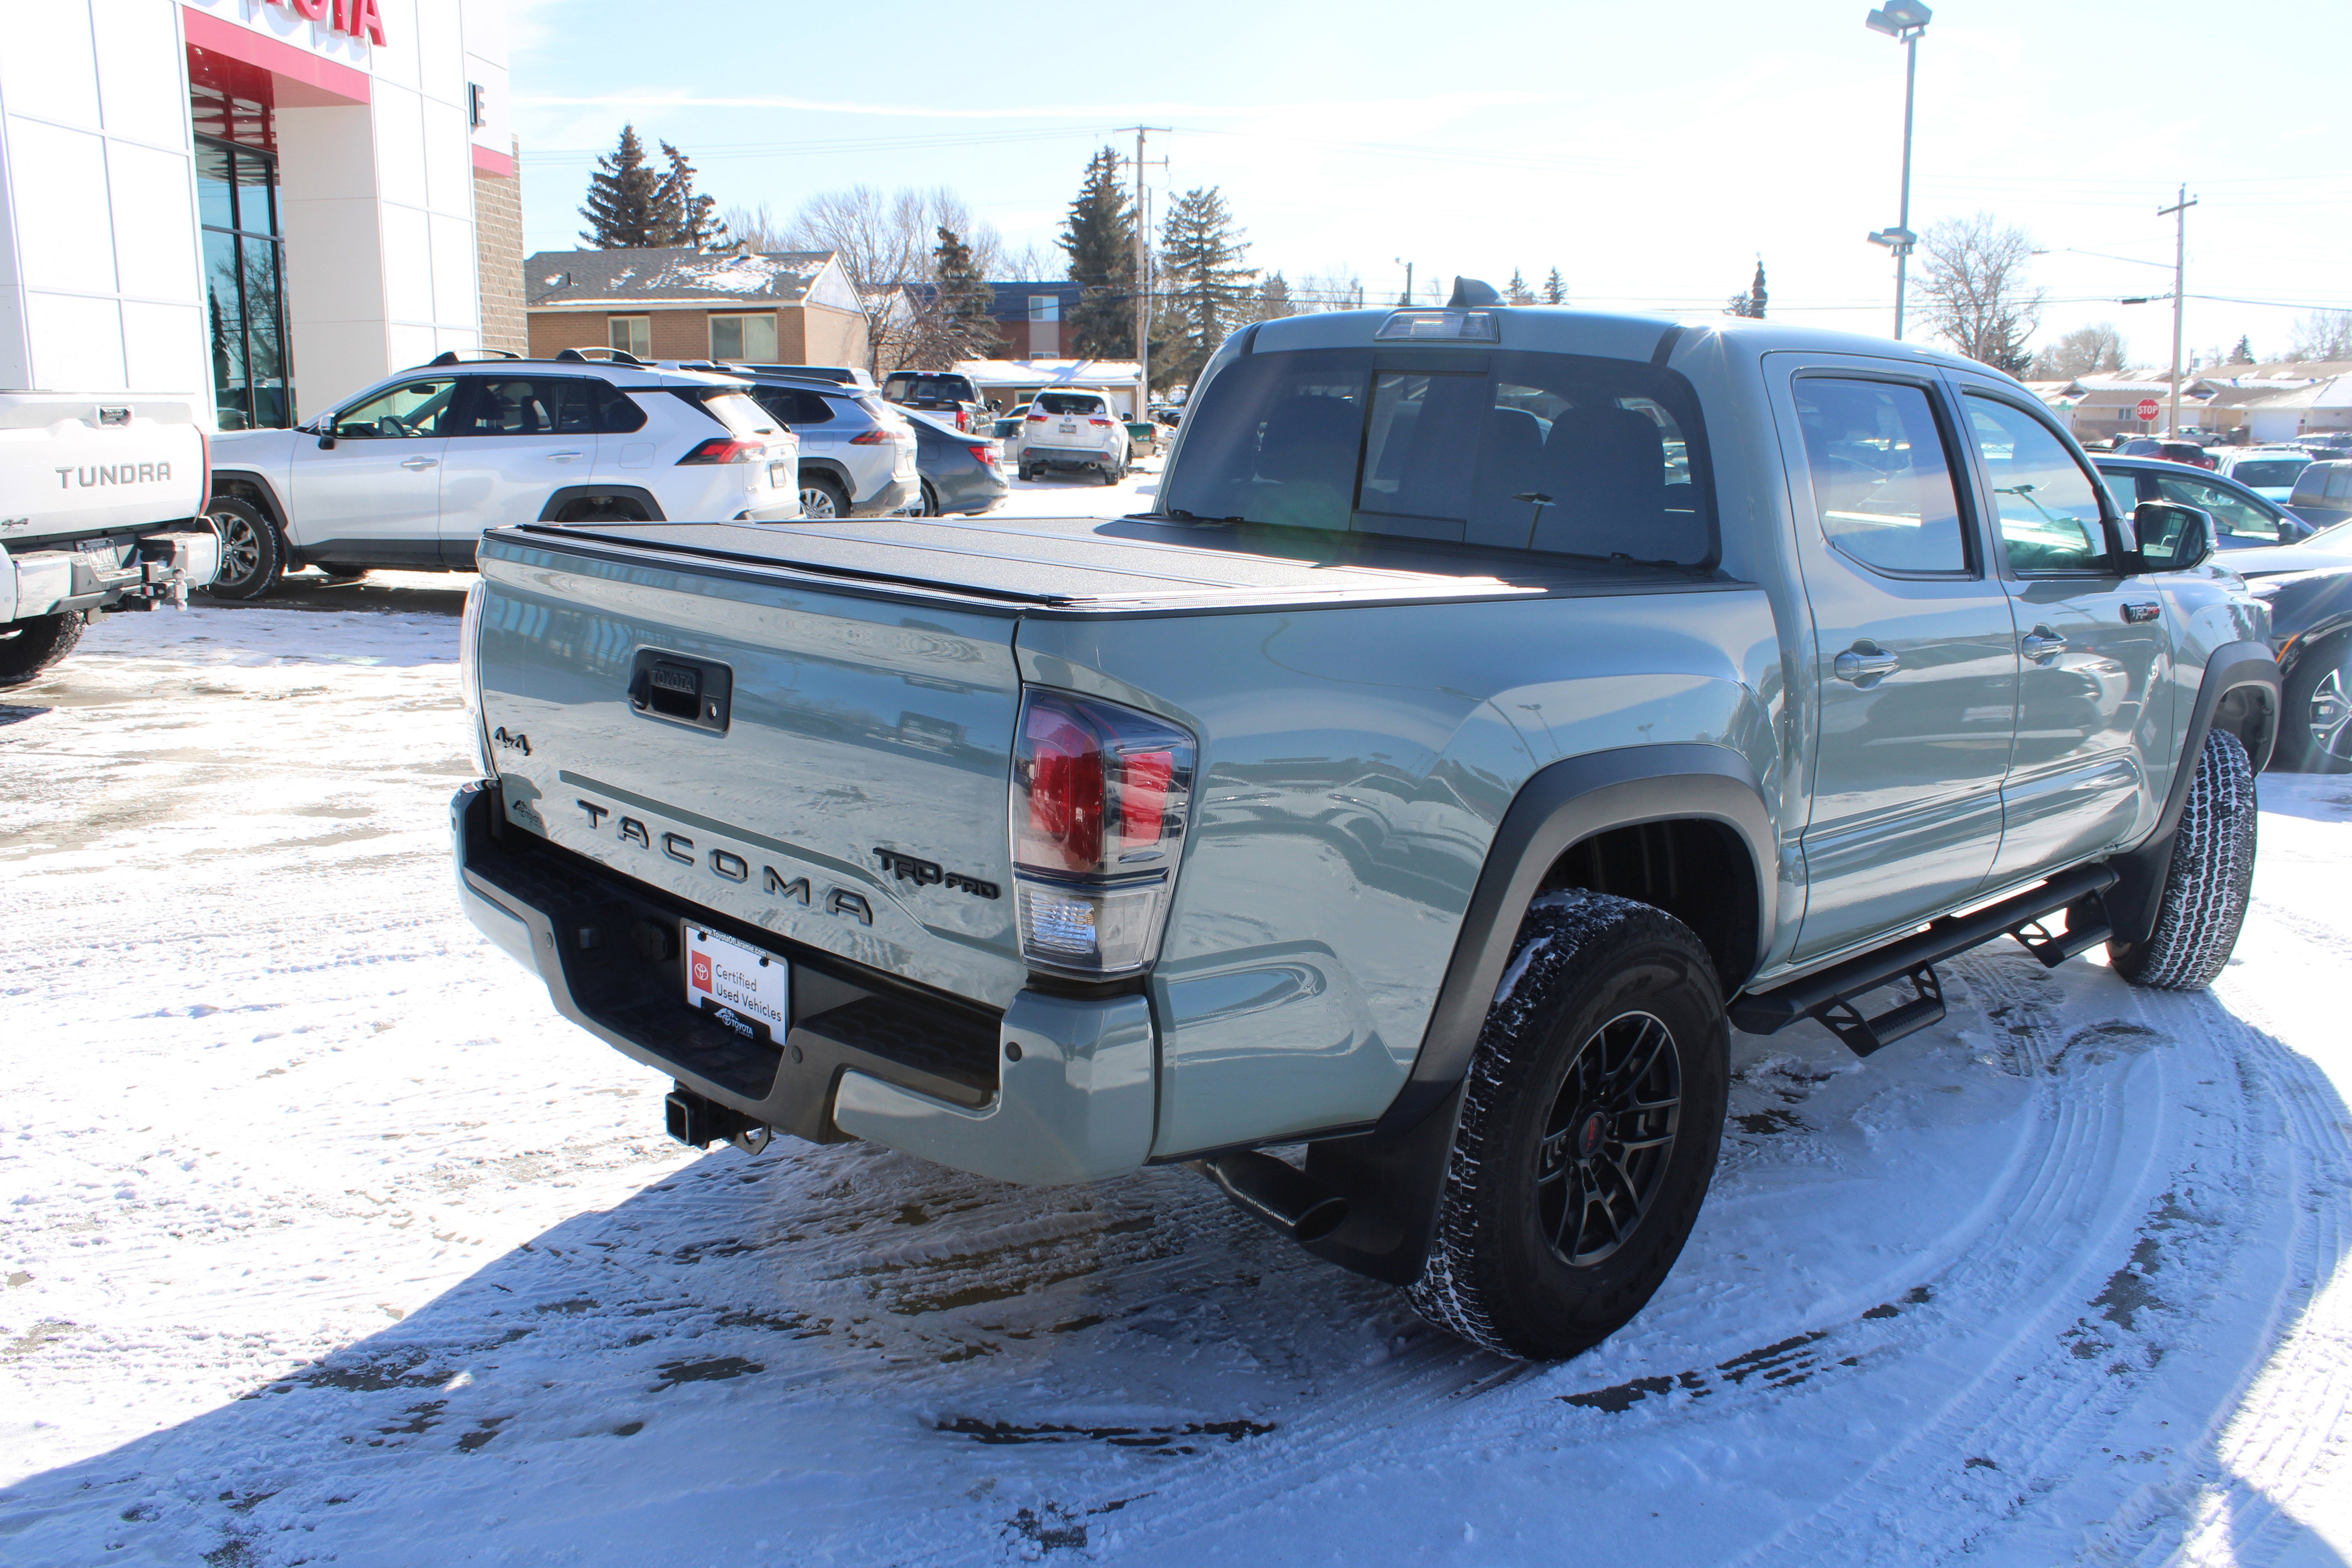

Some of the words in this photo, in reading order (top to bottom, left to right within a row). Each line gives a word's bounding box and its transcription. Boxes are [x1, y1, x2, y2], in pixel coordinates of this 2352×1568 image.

[2137, 405, 2158, 415] STOP
[54, 461, 171, 489] TUNDRA
[652, 670, 694, 691] TOYOTA
[577, 799, 873, 927] TACOMA
[873, 847, 944, 886] TRD
[944, 871, 1002, 900] PRO
[699, 926, 767, 957] www.ToyotaOfLaramie.com
[716, 964, 757, 993] Certified
[717, 982, 739, 1004] Used
[742, 993, 782, 1022] Vehicles
[731, 1019, 753, 1035] TOYOTA
